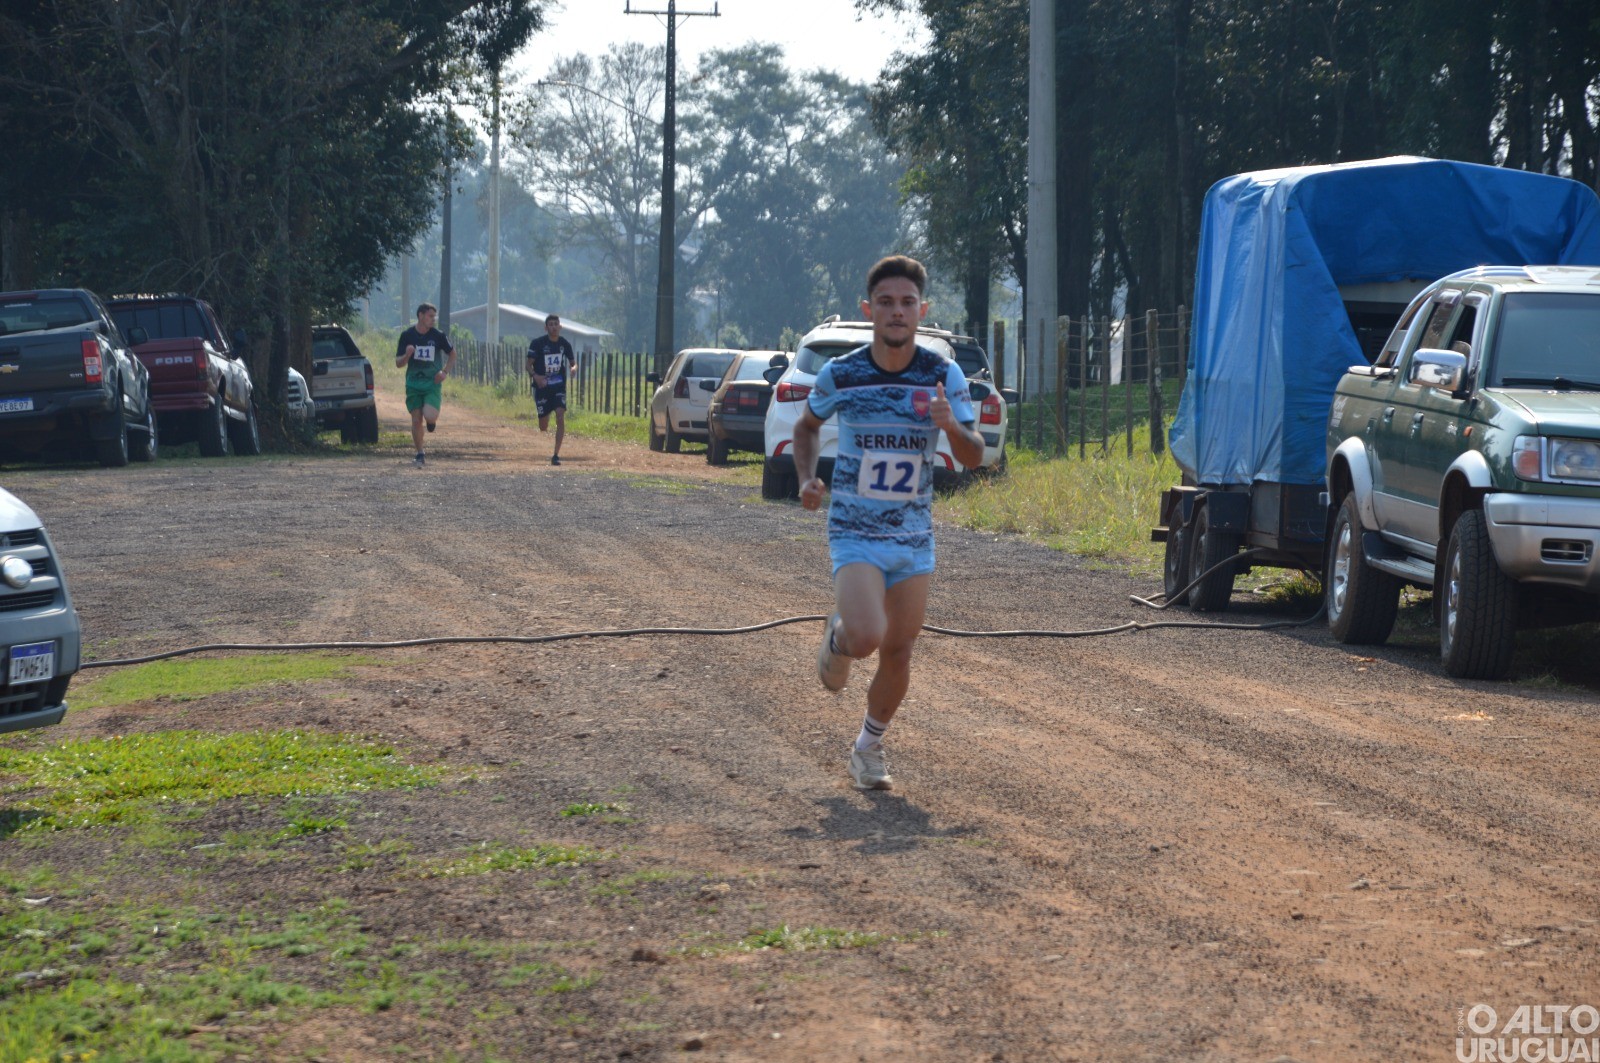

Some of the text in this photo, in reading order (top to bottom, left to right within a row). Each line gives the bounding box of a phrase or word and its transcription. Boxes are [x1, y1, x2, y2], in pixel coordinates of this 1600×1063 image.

[417, 348, 431, 359] 11
[155, 355, 193, 366] FORD
[547, 356, 560, 366] 14
[854, 433, 928, 450] SERRANO
[869, 460, 915, 494] 12
